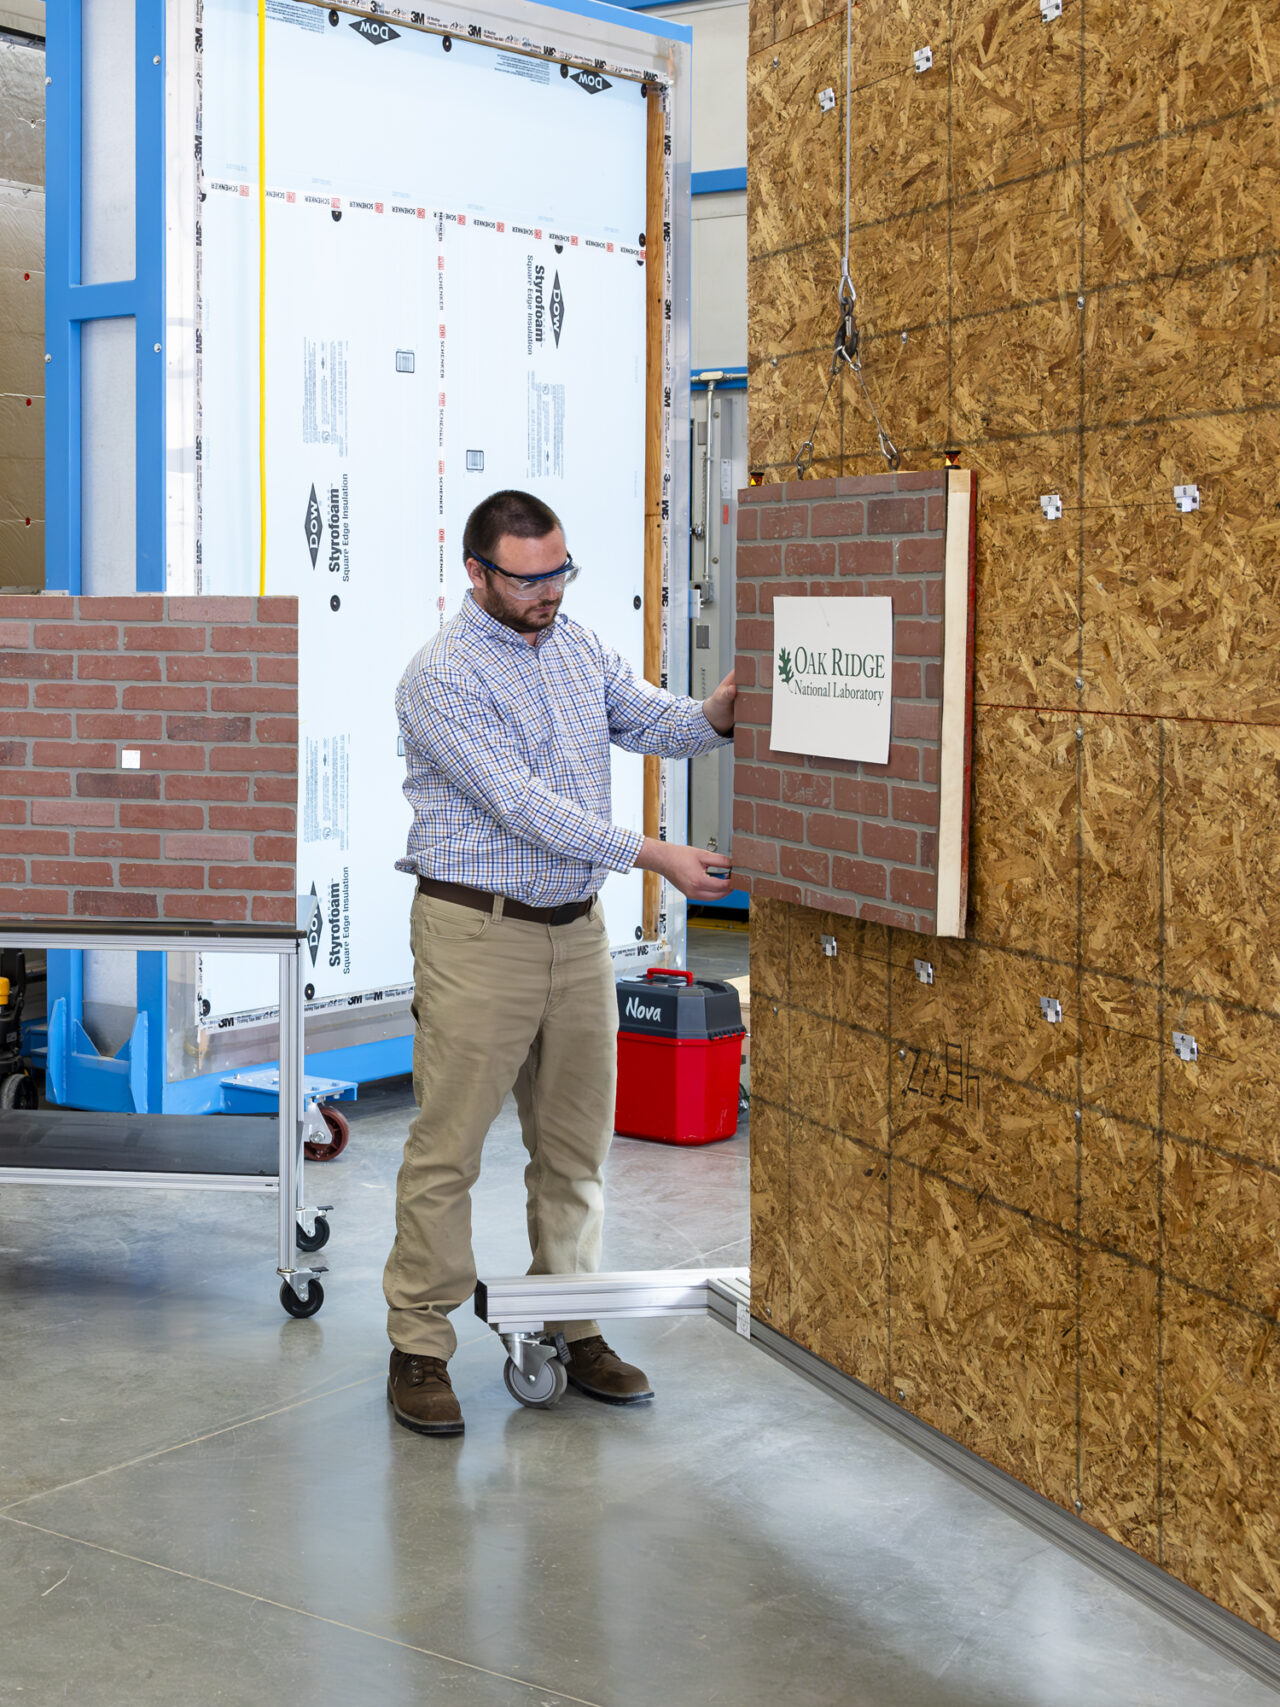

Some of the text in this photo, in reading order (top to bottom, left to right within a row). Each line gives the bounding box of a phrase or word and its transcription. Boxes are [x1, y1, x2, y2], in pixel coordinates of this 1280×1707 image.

[410, 11, 425, 25] 3M
[468, 24, 482, 38] 3M
[266, 190, 285, 199] SCHENK
[349, 201, 374, 210] SCHENKER
[392, 206, 416, 215] SCHENKER
[473, 219, 495, 229] SCHENKER
[512, 226, 533, 236] SCHENKER
[549, 233, 570, 242] SCHENKER
[534, 265, 545, 342] Styrofoam
[328, 489, 342, 572] Styrofoam
[342, 523, 350, 545] Edge
[342, 549, 350, 582] Square
[831, 648, 885, 678] RIDGE
[794, 679, 884, 706] National Laboratory
[329, 883, 342, 966] Styrofoam
[348, 994, 362, 1006] 3M
[626, 996, 661, 1022] Nova
[218, 1017, 234, 1028] 3M
